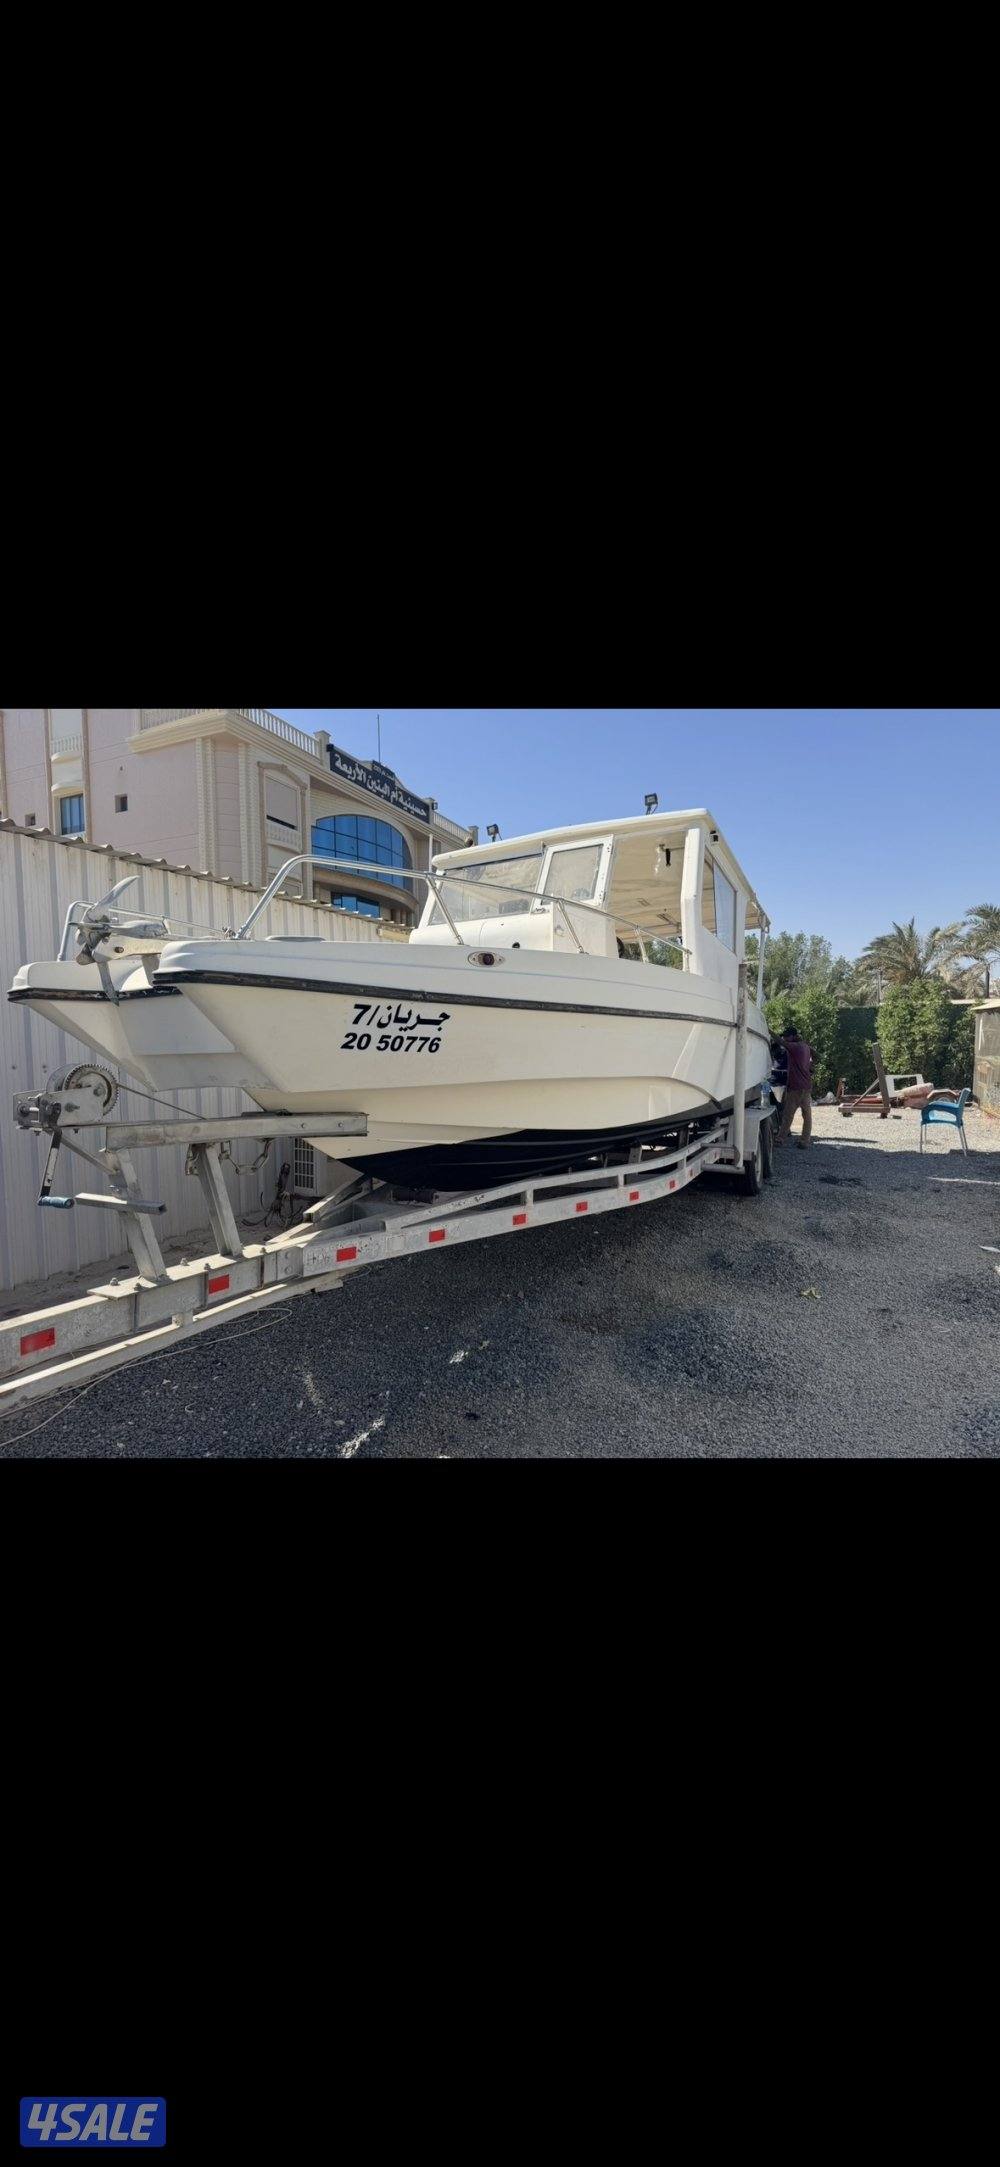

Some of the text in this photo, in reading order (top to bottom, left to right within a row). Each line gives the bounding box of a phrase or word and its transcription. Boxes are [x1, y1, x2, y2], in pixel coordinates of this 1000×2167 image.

[366, 775, 391, 798] البنين
[390, 786, 399, 803] أم
[399, 790, 427, 817] حسينية
[340, 1032, 442, 1054] 20 50776
